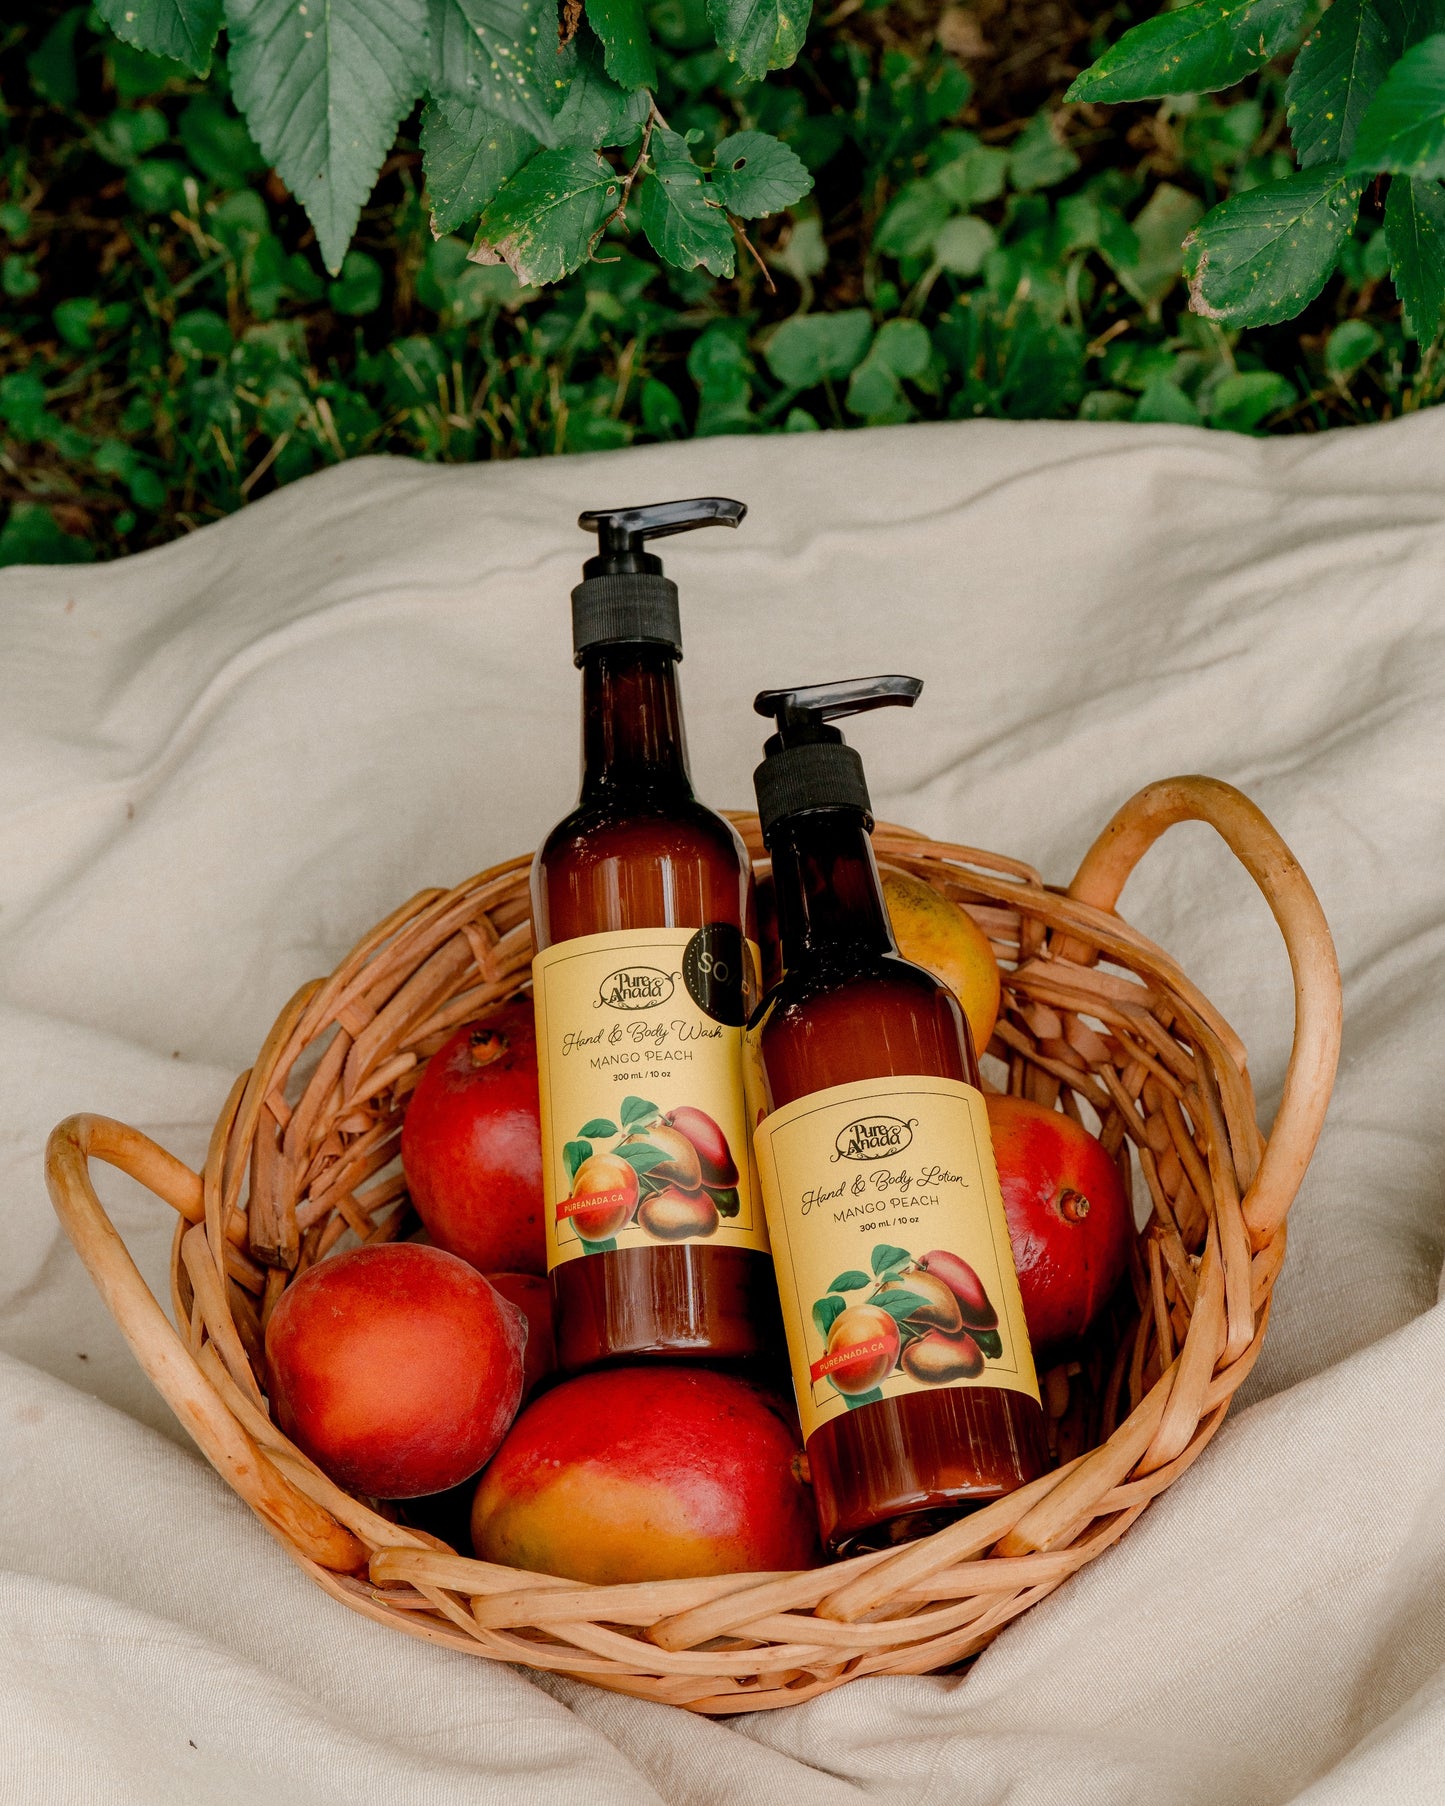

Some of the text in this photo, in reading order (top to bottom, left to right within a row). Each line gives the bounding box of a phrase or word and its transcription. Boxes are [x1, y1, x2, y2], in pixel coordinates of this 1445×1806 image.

[607, 978, 664, 1004] Anada
[613, 973, 651, 993] Pure
[561, 1020, 724, 1056] Hand & Body Wash
[590, 1050, 693, 1069] MANGO PEACH
[612, 1072, 629, 1082] 300
[630, 1071, 644, 1080] mL
[650, 1070, 660, 1078] 10
[846, 1126, 901, 1156] Anada
[849, 1124, 888, 1144] Pure
[801, 1165, 969, 1215] Hand & Body Lotion
[833, 1195, 939, 1223] MANGO PEACH
[859, 1222, 876, 1232] 300
[877, 1219, 891, 1228] mL
[897, 1216, 908, 1225] 10
